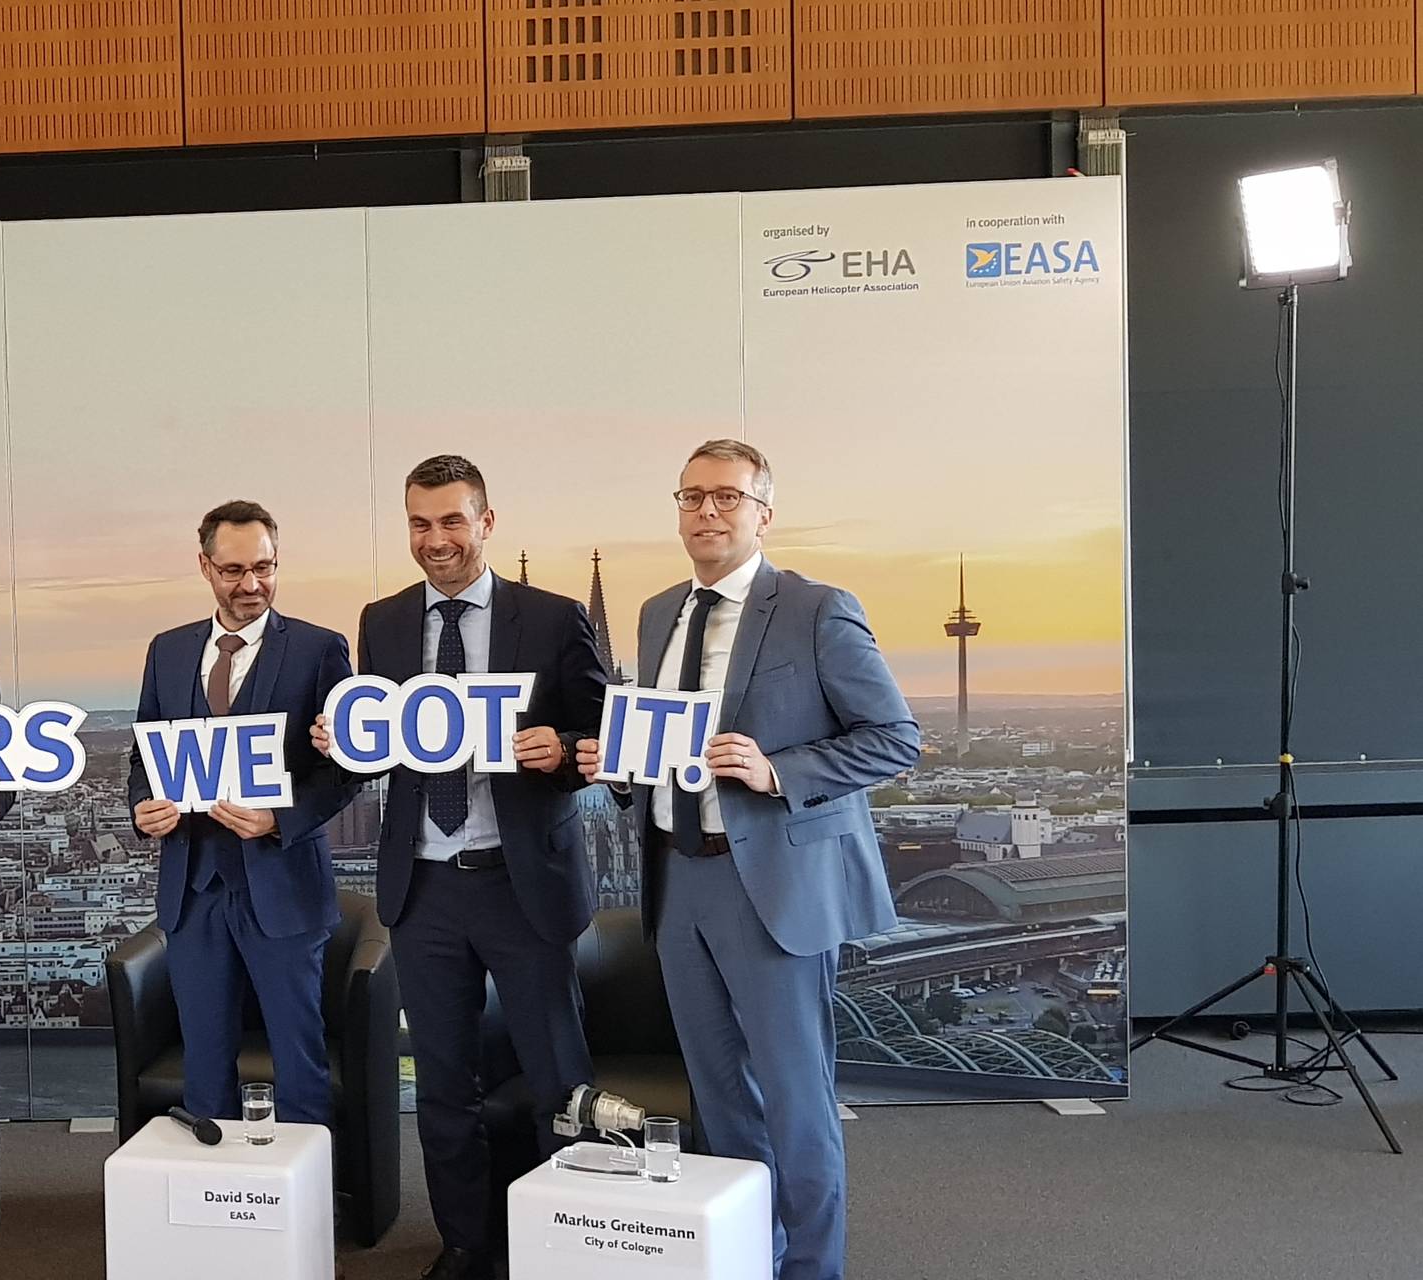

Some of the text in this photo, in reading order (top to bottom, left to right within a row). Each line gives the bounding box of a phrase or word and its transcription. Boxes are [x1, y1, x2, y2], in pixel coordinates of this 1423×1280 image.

[762, 224, 830, 240] organised by
[966, 213, 1065, 229] in cooperation with
[843, 249, 915, 277] EHA
[1005, 241, 1099, 275] EASA
[761, 282, 919, 298] European Helicopter Association
[333, 685, 522, 764] GOT
[603, 695, 711, 785] IT!
[148, 725, 282, 803] WE
[204, 1190, 281, 1206] David Solar
[229, 1211, 257, 1221] EASA
[553, 1212, 695, 1239] Markus Greitemann
[584, 1236, 664, 1256] City of Cologne
